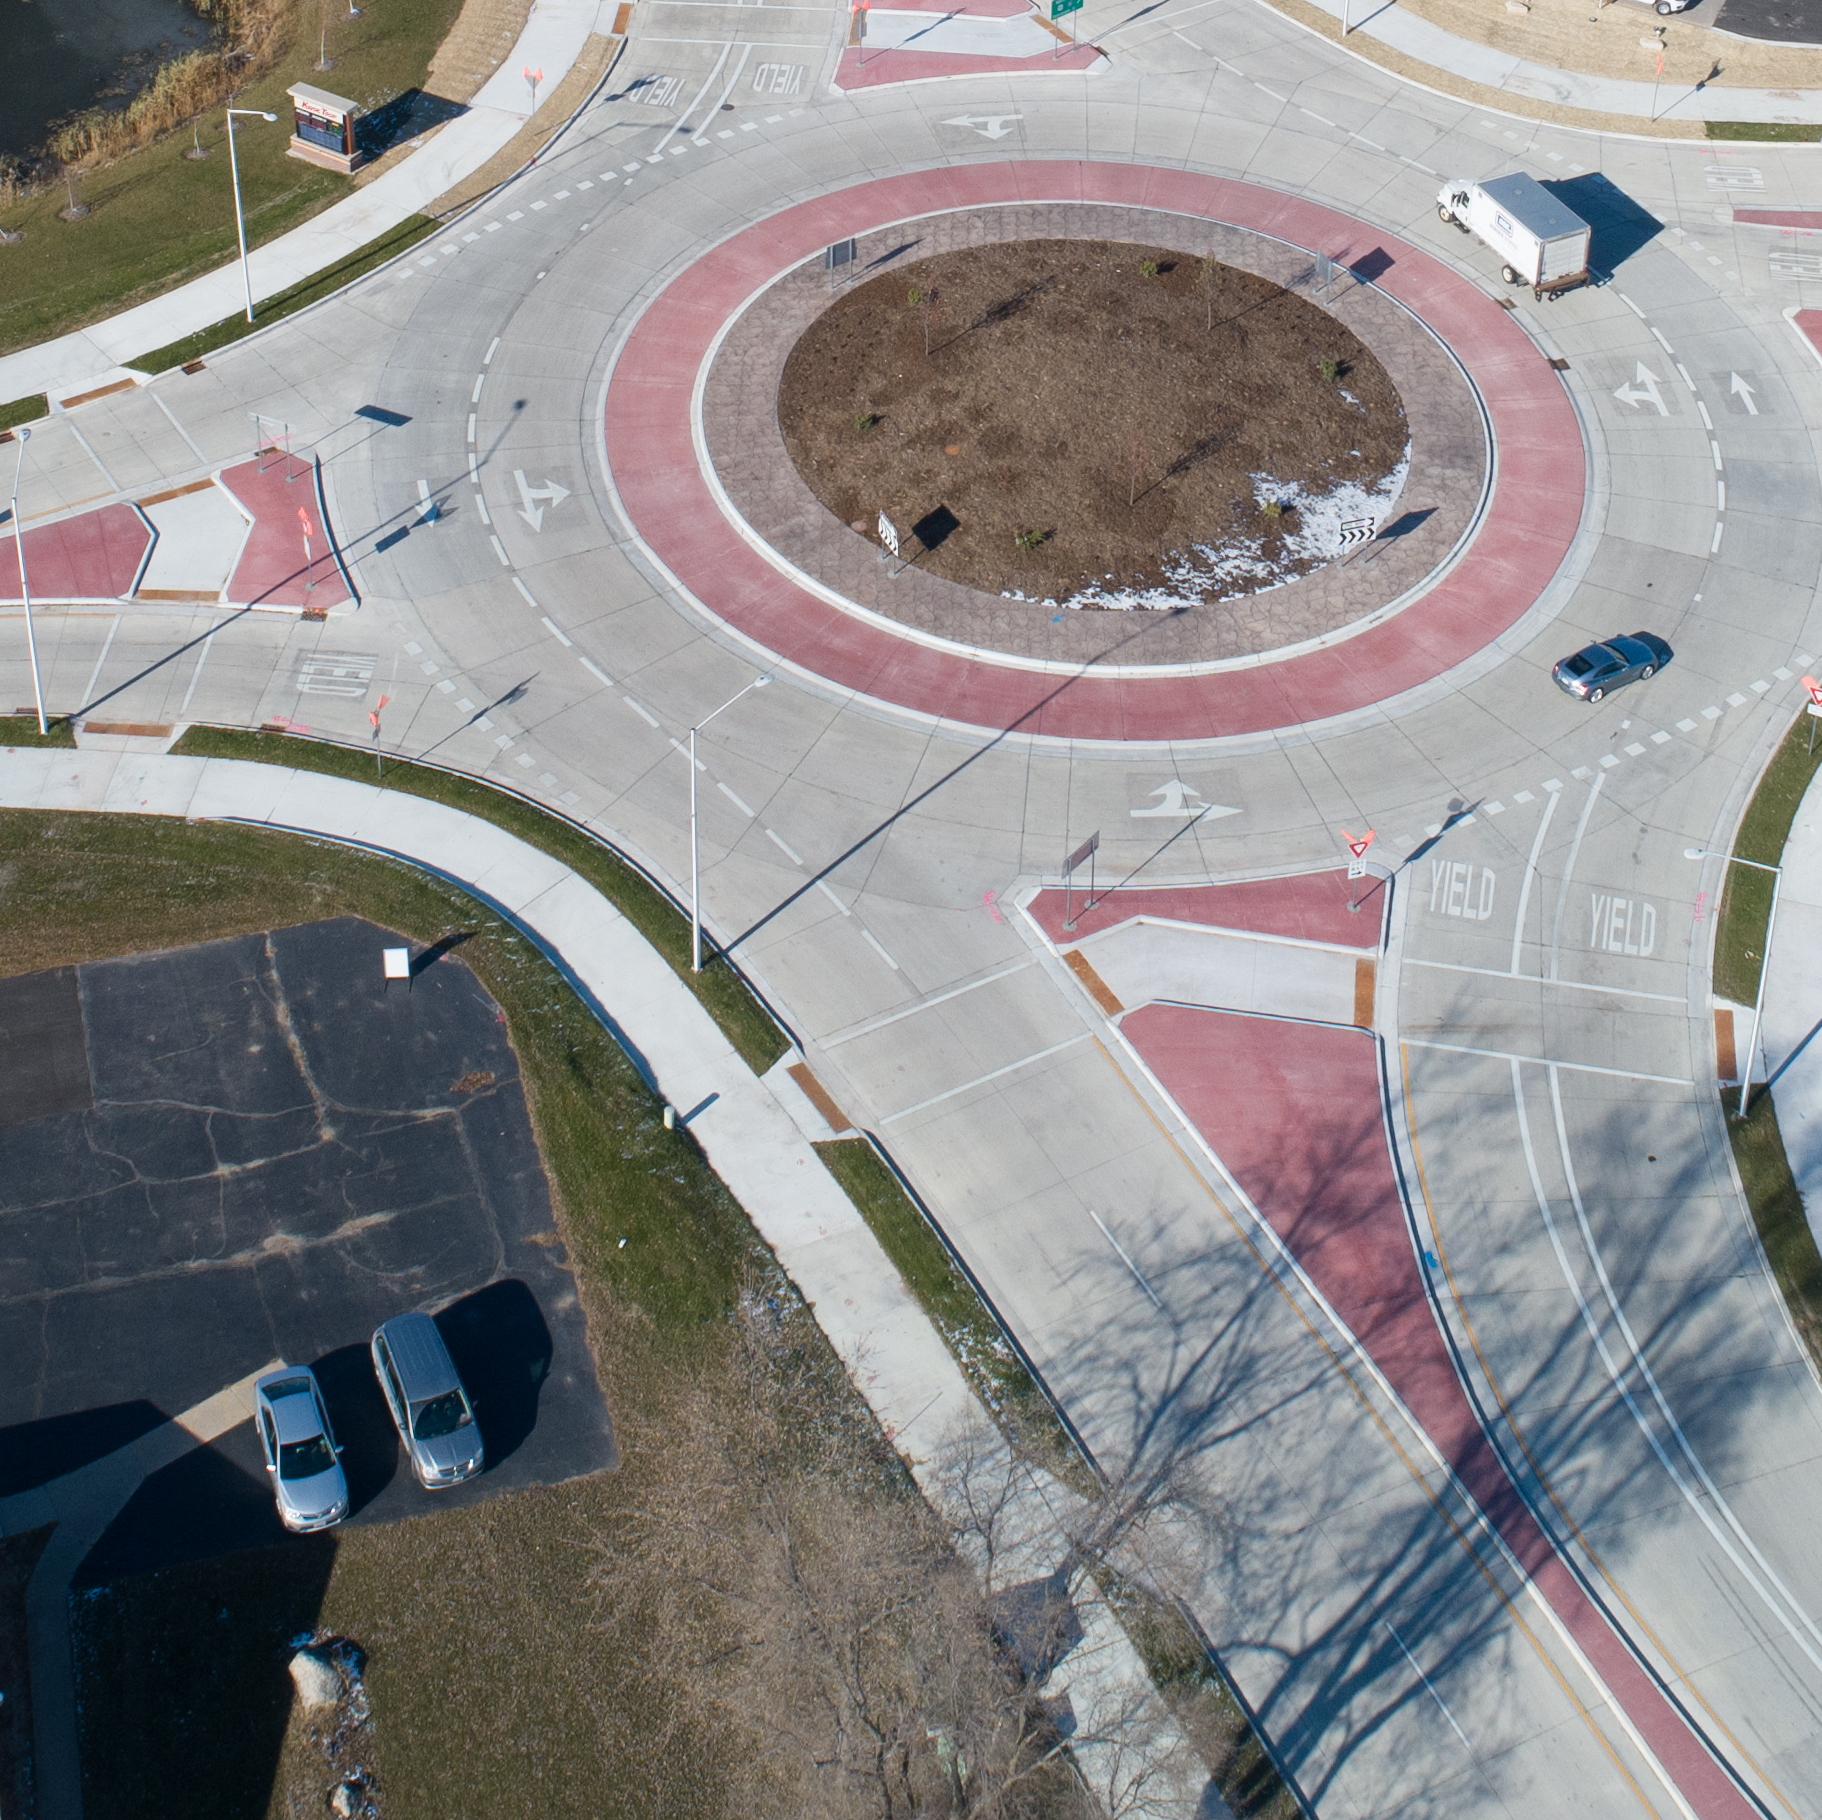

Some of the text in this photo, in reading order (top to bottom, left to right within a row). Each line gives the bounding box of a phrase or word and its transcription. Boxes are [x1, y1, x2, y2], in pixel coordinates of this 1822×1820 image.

[629, 74, 686, 107] YIELD
[753, 63, 804, 95] YIELD
[1704, 165, 1767, 193] YIELD
[296, 654, 378, 696] YIELD
[1430, 859, 1496, 921] YIELD
[1590, 893, 1657, 957] YIELD
